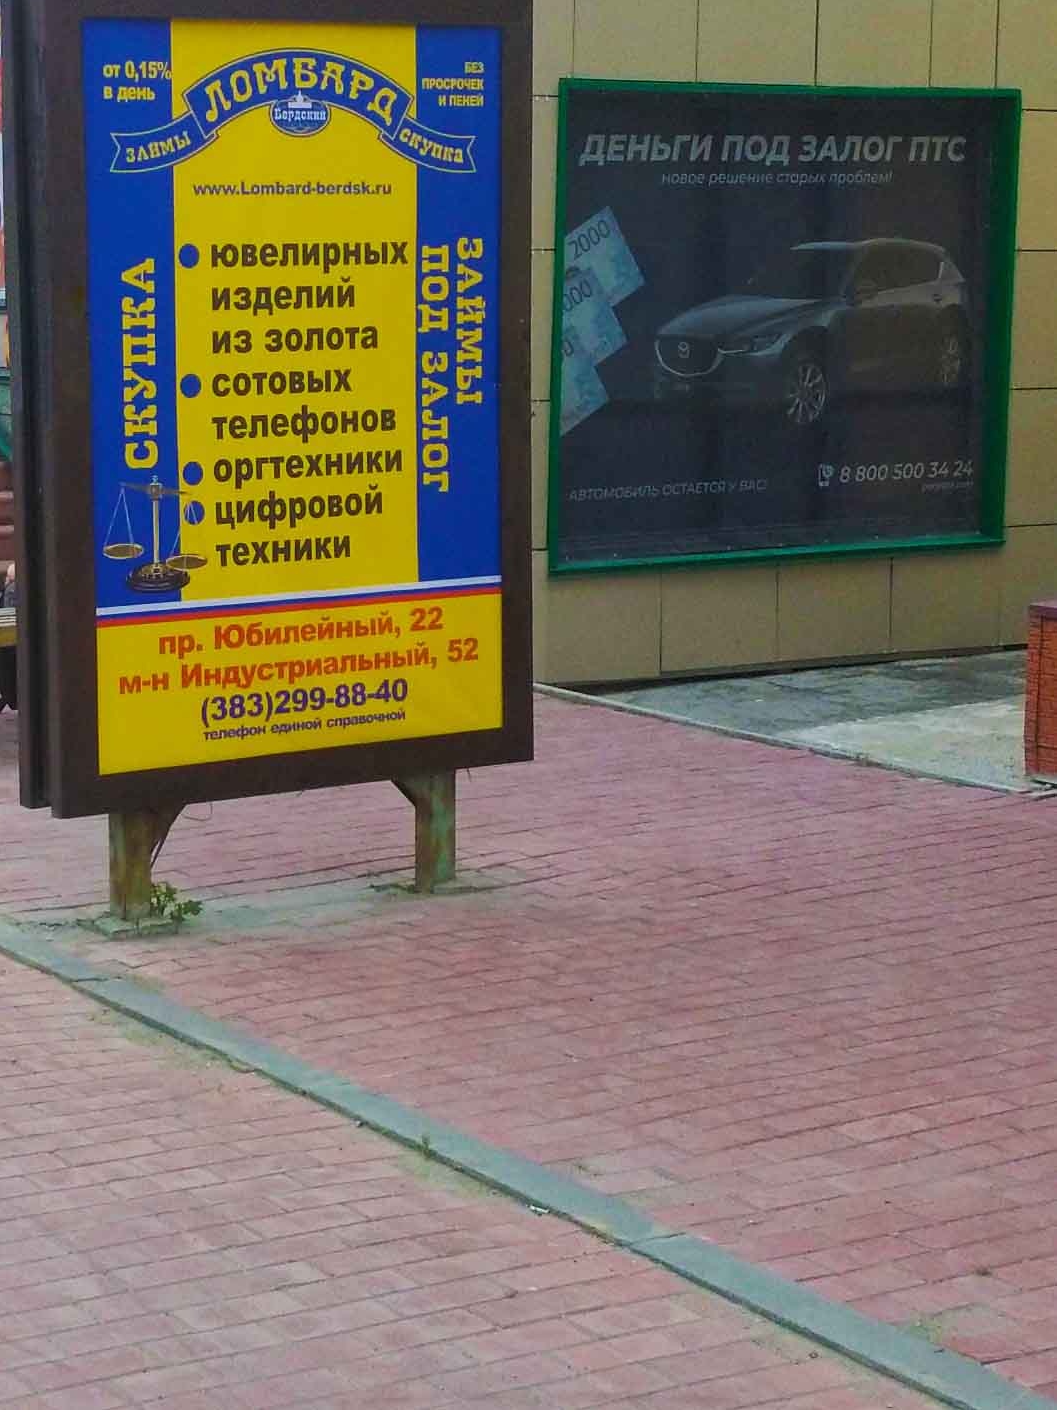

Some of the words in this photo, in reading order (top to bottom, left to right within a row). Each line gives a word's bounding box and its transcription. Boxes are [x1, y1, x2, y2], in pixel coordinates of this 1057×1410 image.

[102, 64, 121, 78] от
[124, 60, 172, 82] 0,15%
[422, 77, 484, 90] ПРОСРОЧЕК
[464, 61, 484, 74] БЕЗ
[103, 86, 113, 100] в
[117, 86, 155, 102] день
[205, 56, 398, 126] ЛОМБАРД
[438, 94, 446, 107] И
[449, 92, 484, 107] ПЕНЕЙ
[578, 134, 714, 166] ДЕНЬГИ
[720, 134, 792, 167] ПОД
[797, 134, 903, 163] ЗАЛОГ
[908, 134, 967, 163] ПТС
[192, 181, 392, 196] www.Lombard-berdsk.ru
[661, 173, 705, 185] новое
[708, 172, 773, 187] решение
[775, 172, 827, 187] старых
[828, 169, 894, 187] проблем!
[210, 240, 409, 273] ювелирных
[567, 219, 611, 260] 2000
[211, 276, 355, 316] изделий
[421, 245, 450, 334] ПОД
[455, 237, 486, 405] ЗАЙМЫ
[211, 330, 253, 355] из
[263, 325, 379, 353] золота
[121, 258, 159, 470] СКУПКА
[211, 368, 353, 398] сотовых
[211, 405, 397, 444] телефонов
[421, 351, 450, 494] ЗАЛОГ
[213, 449, 403, 489] оргтехники
[838, 463, 851, 484] 8
[854, 463, 889, 483] 800
[893, 462, 925, 480] 500
[927, 461, 950, 479] 34
[951, 459, 975, 478] 24
[214, 484, 383, 530] цифровой
[569, 484, 661, 501] АВТОМОБИЛЬ
[214, 534, 352, 568] техники
[158, 633, 203, 660] пр.
[213, 611, 402, 651] Юбилейный,
[409, 605, 443, 632] 22
[119, 671, 170, 696] м-н
[180, 642, 439, 691] Индустриальный,
[447, 637, 479, 663] 52
[200, 677, 409, 730] (383)299-88-40
[202, 723, 267, 742] телефон
[270, 716, 322, 735] единой
[326, 707, 406, 730] справочной
